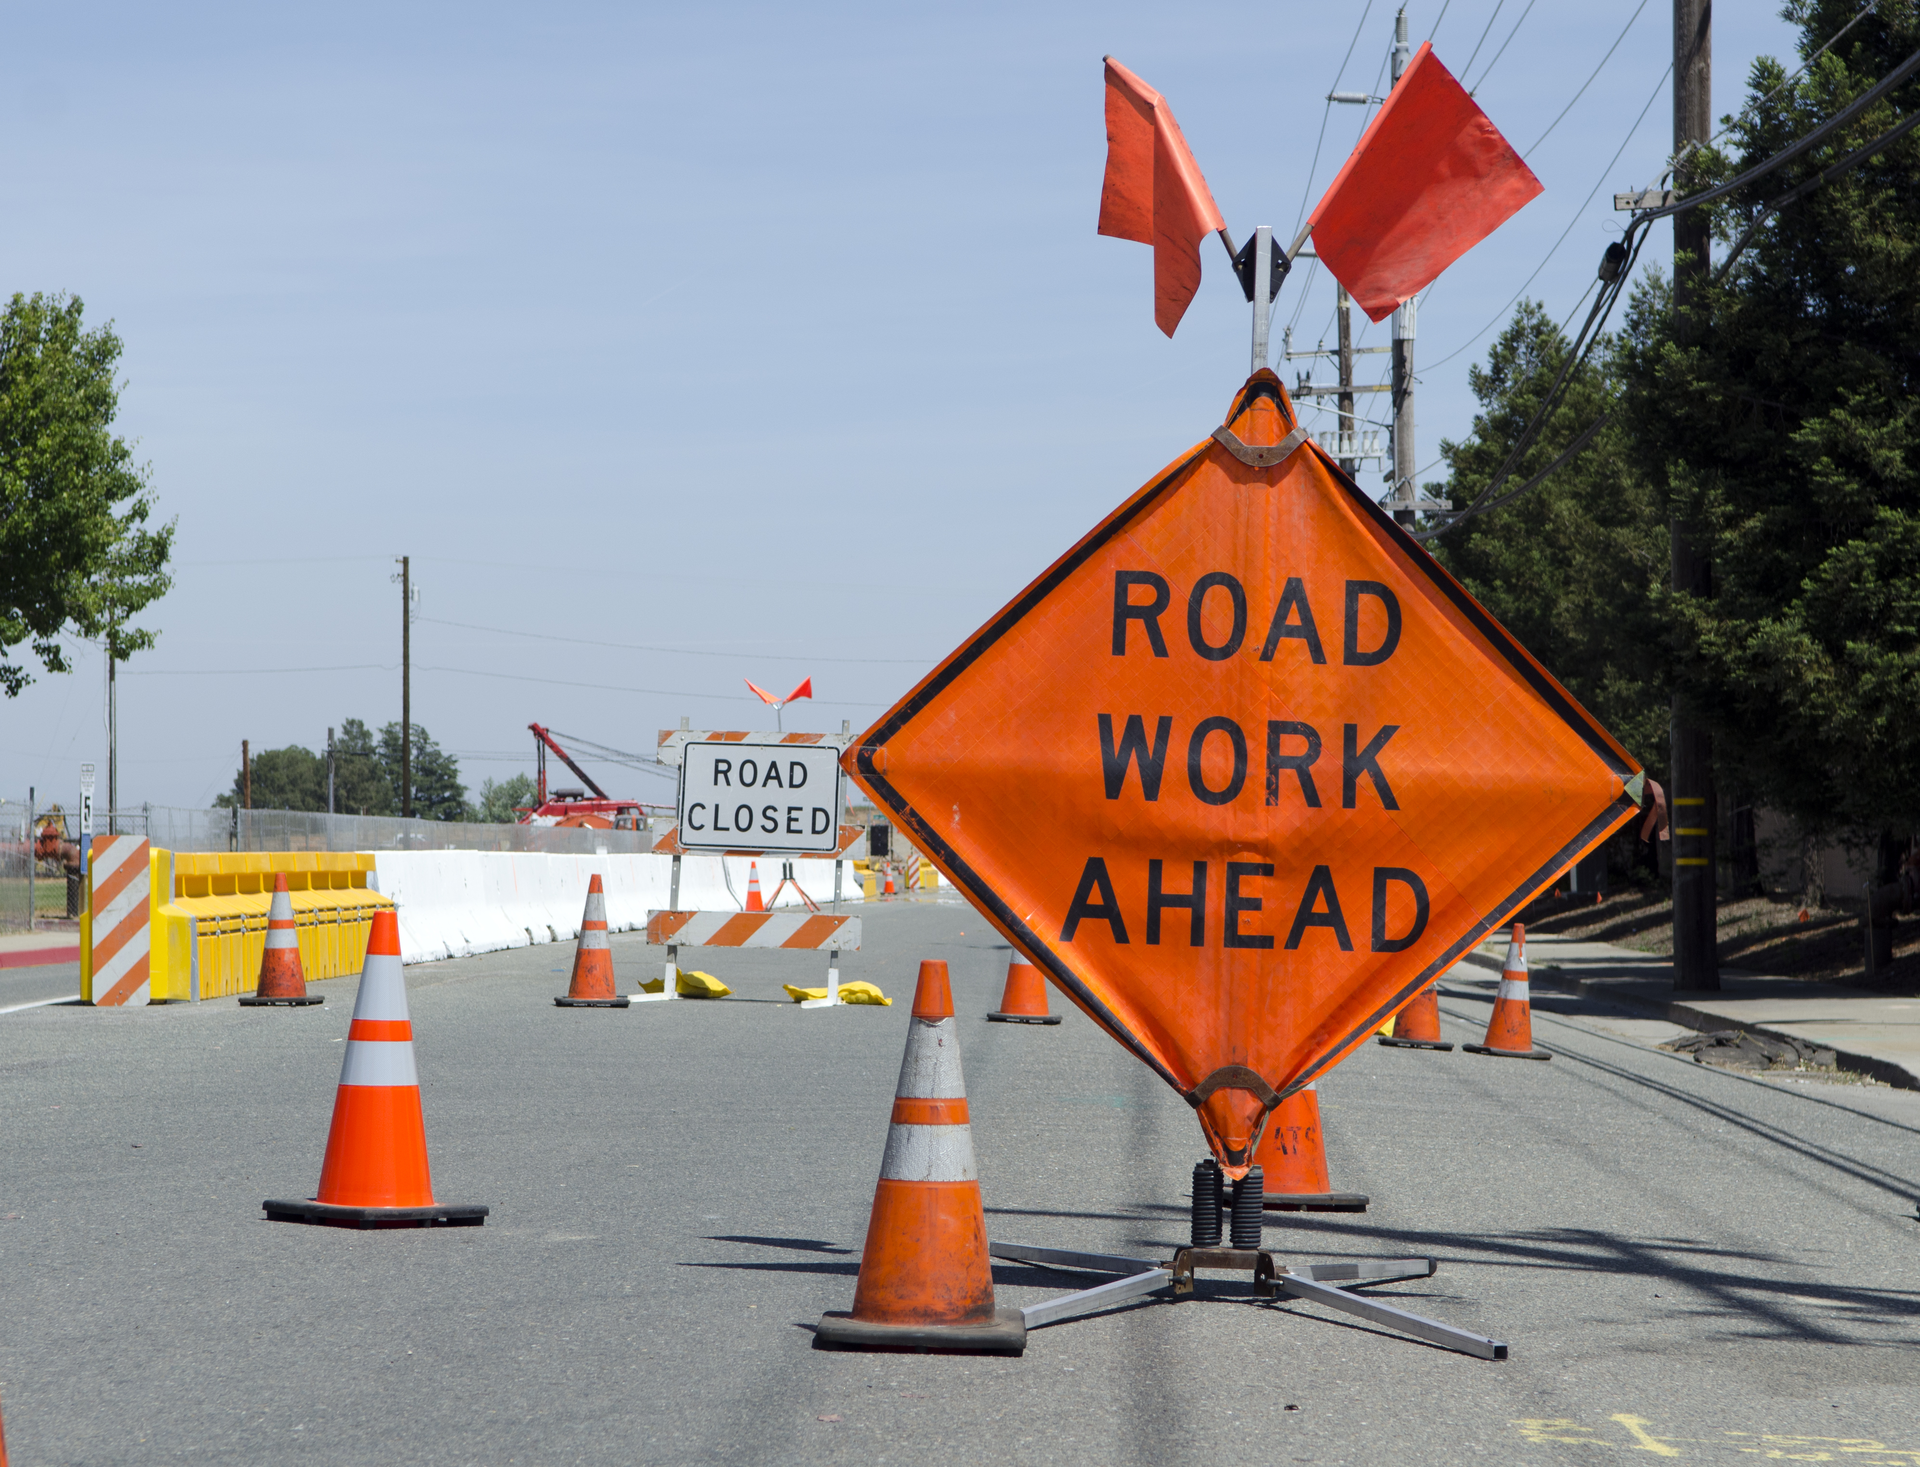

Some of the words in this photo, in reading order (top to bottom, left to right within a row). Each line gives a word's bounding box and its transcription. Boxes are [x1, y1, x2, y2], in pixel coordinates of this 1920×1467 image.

[1111, 570, 1402, 666] ROAD
[713, 758, 808, 788] ROAD
[1097, 713, 1401, 811] WORK
[84, 796, 91, 823] 5
[687, 802, 831, 835] CLOSED
[1059, 856, 1430, 953] AHEAD
